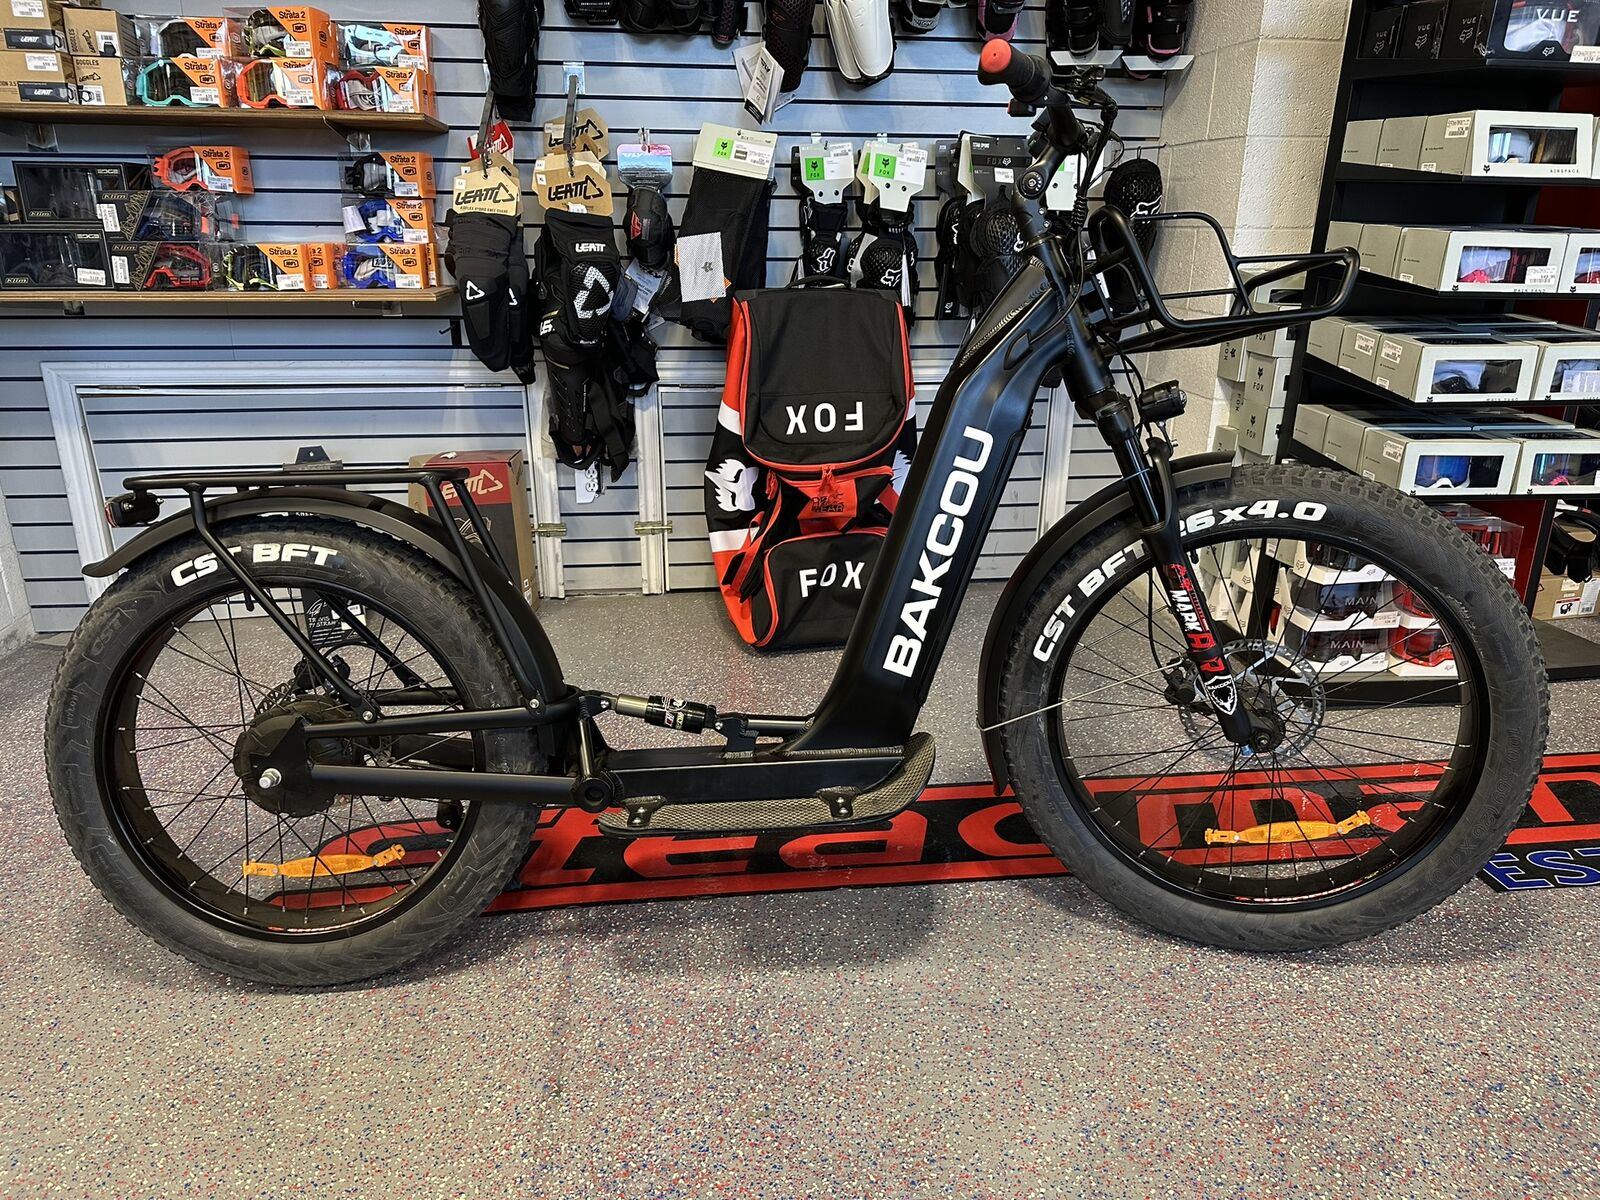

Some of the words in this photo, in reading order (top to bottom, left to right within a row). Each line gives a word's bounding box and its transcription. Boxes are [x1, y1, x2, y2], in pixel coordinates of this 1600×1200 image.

[1462, 16, 1476, 24] VUE
[1536, 8, 1580, 22] VUE
[455, 186, 499, 205] LEATT
[548, 180, 590, 201] LEATT
[576, 242, 606, 252] LEATT
[1253, 382, 1264, 392] FOX
[786, 401, 864, 435] FOX
[1247, 429, 1256, 439] FOX
[252, 543, 338, 566] BFT
[883, 426, 994, 677] BAKCOU
[799, 561, 864, 598] FOX
[1033, 594, 1075, 662] CST
[1078, 539, 1146, 598] BFT
[1345, 596, 1377, 606] MAIN
[1170, 590, 1202, 634] MARK
[1330, 640, 1365, 649] MAIN
